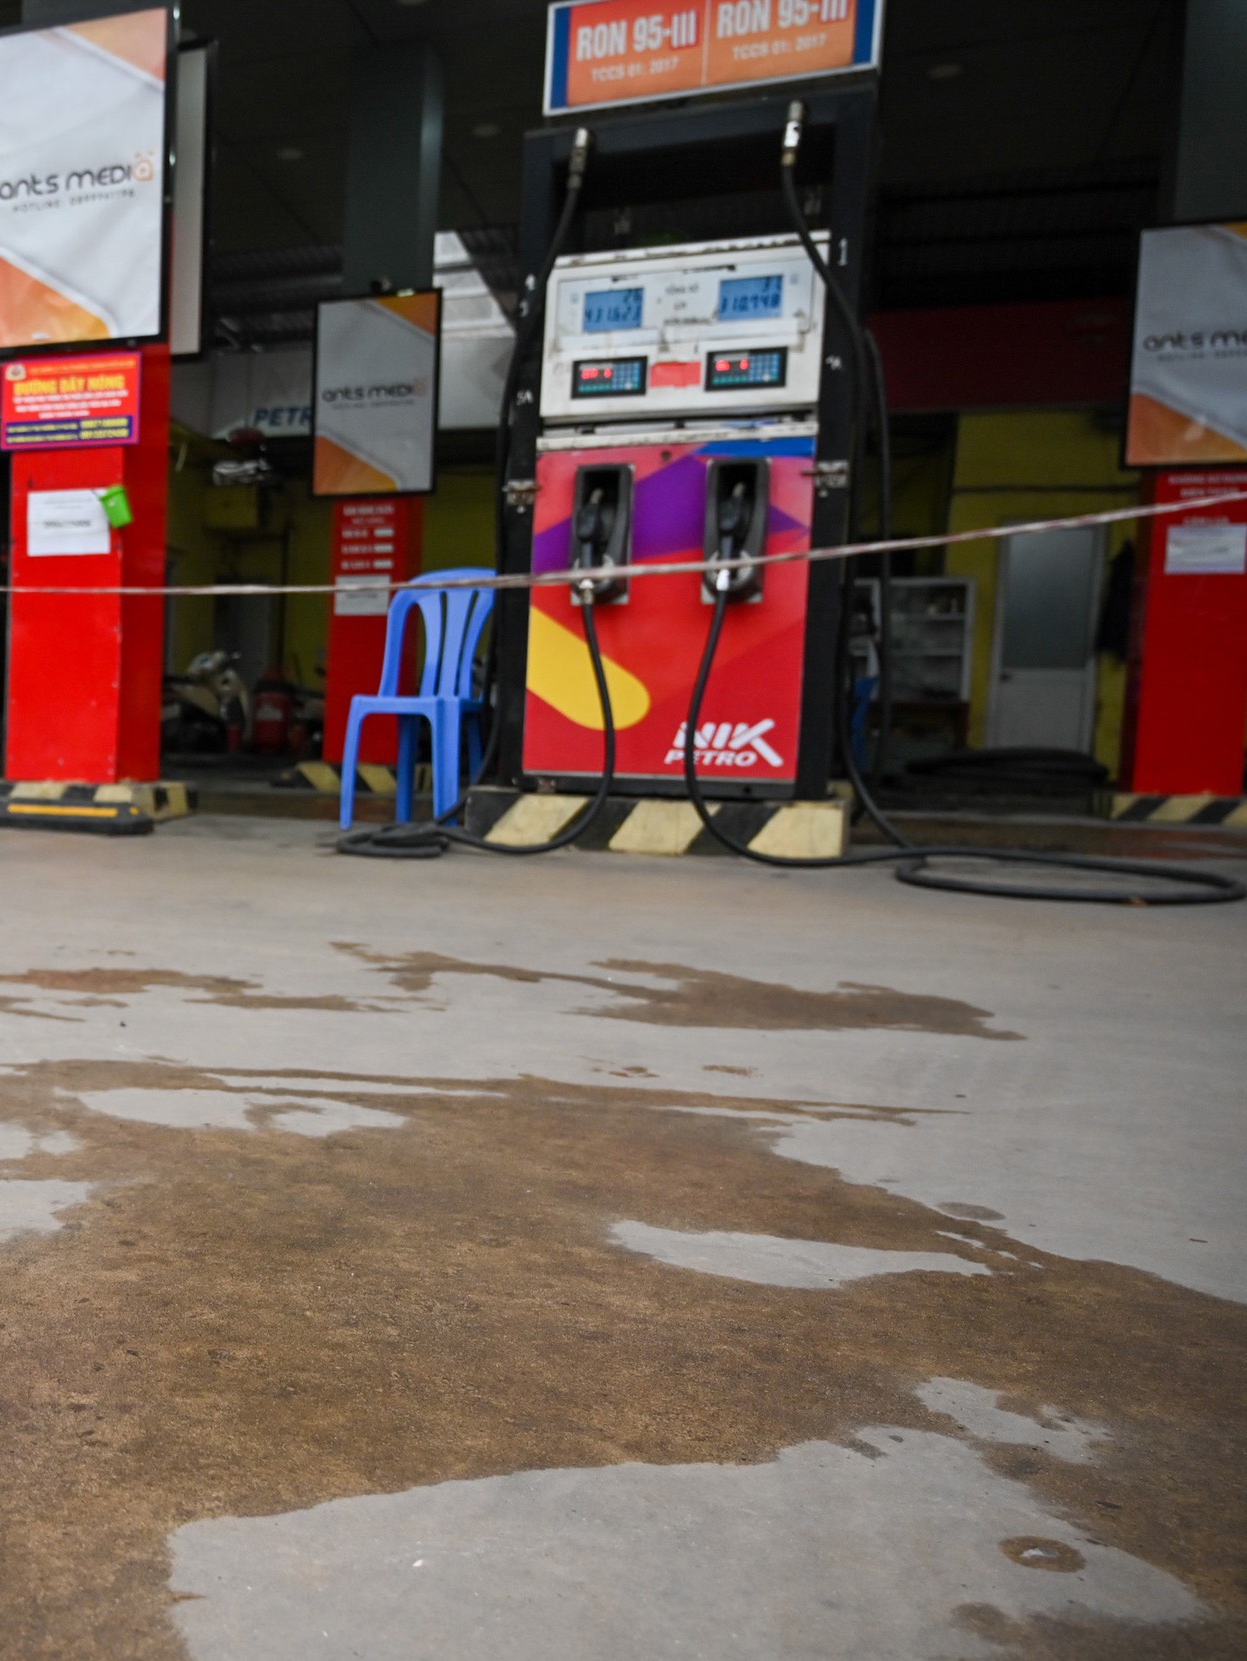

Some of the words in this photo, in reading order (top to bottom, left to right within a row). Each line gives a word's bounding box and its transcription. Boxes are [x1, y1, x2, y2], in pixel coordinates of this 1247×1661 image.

[576, 19, 627, 62] RON
[633, 9, 697, 53] 95-III
[717, 0, 772, 38] RON
[673, 718, 784, 767] NIK
